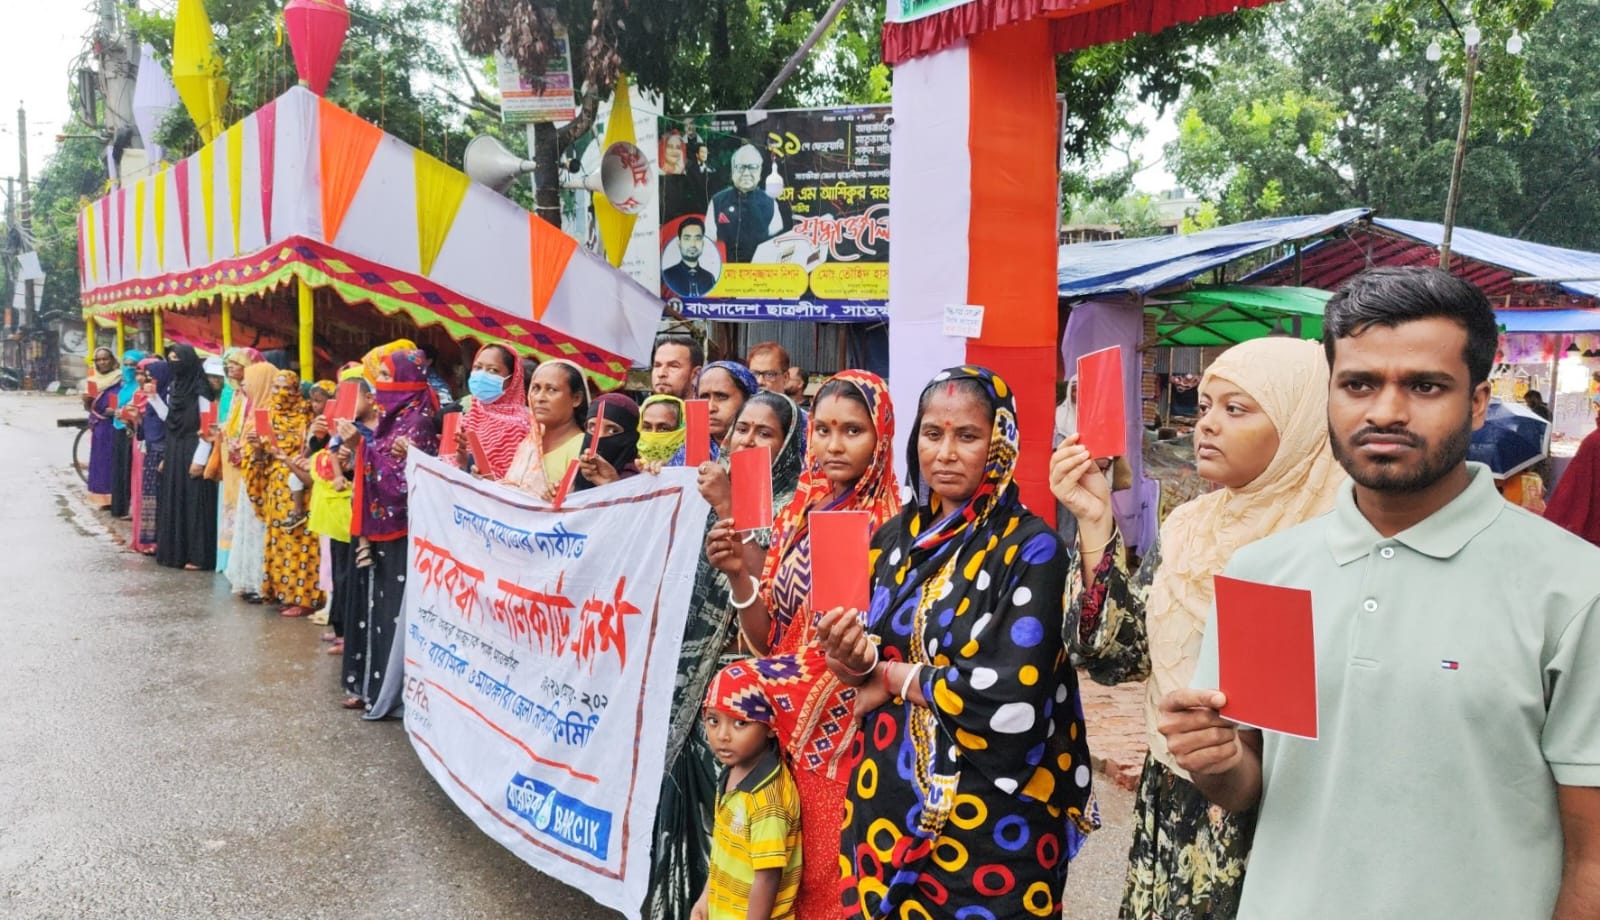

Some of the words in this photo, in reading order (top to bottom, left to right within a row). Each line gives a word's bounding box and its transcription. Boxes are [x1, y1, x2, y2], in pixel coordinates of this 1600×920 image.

[768, 131, 801, 157] ২১
[797, 186, 817, 201] এম
[819, 180, 867, 206] আশিকুর
[868, 184, 890, 200] রহ
[873, 269, 889, 280] হাস
[684, 302, 762, 316] বাংলাদেশ
[552, 804, 601, 851] BARCIK
